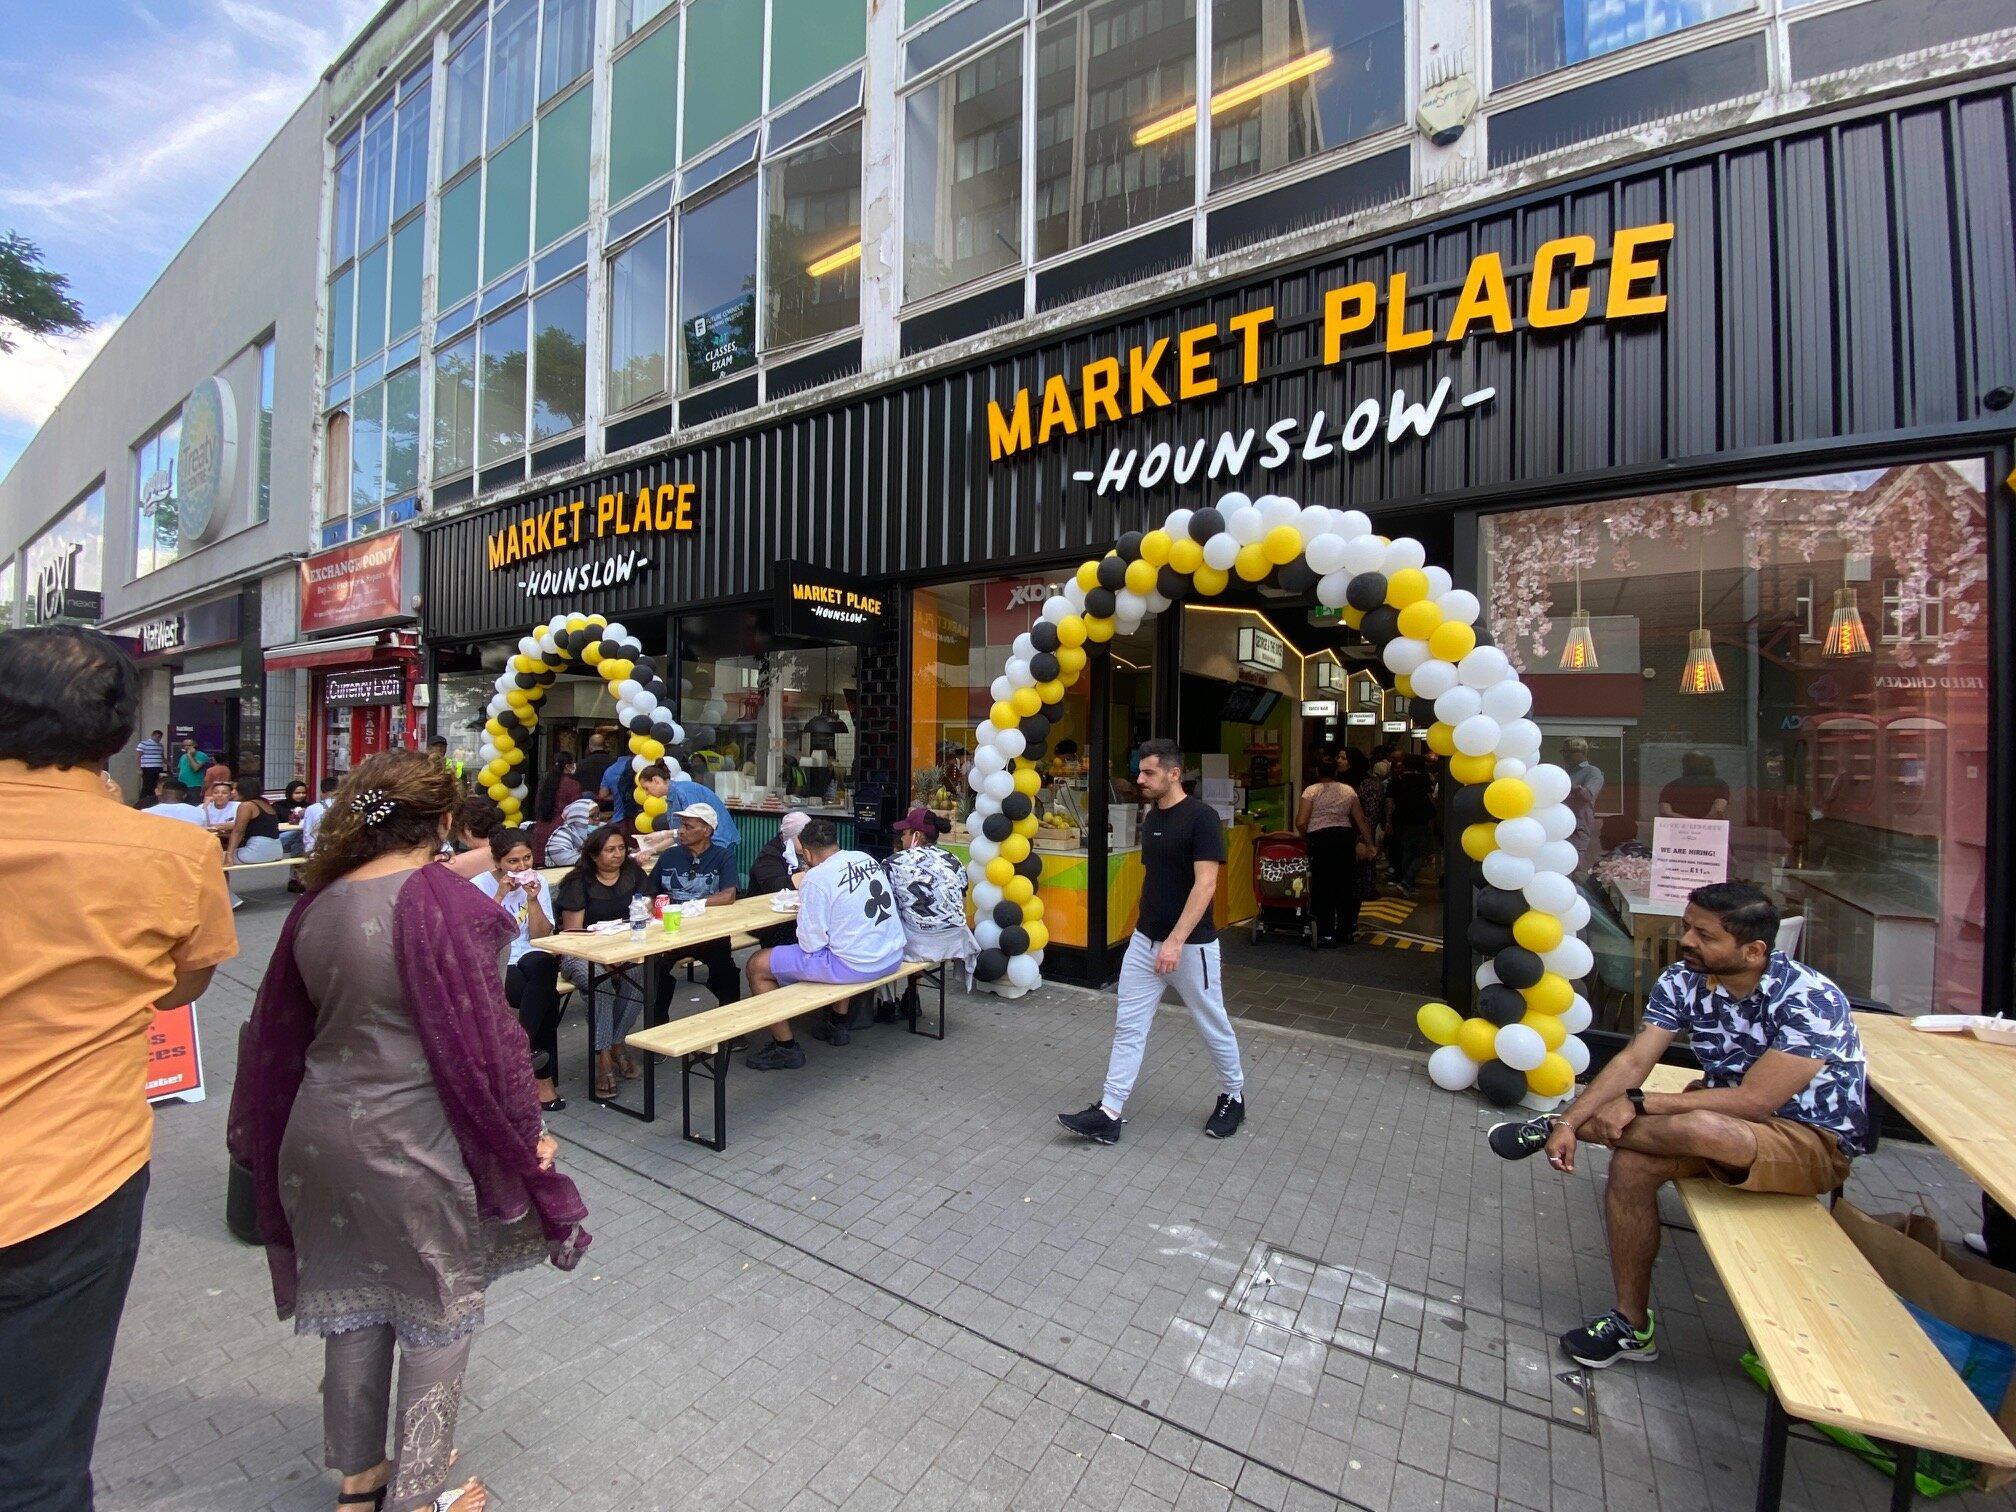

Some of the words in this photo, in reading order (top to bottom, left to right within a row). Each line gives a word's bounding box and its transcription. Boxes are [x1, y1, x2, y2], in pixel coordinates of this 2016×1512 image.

[705, 341, 738, 362] CLASSES,
[987, 305, 1275, 462] MARKET
[1323, 223, 1674, 366] PLACE
[711, 355, 733, 372] EXAM
[183, 435, 216, 478] Treaty
[488, 501, 584, 571] MARKET
[597, 483, 696, 538] PLACE
[361, 546, 395, 569] POINT
[36, 543, 83, 624] next
[793, 583, 842, 605] MARKET
[846, 592, 882, 615] PLACE
[66, 598, 98, 609] next
[143, 616, 179, 653] NatWest
[329, 680, 371, 702] Currency
[365, 711, 375, 745] FAST
[1689, 849, 1716, 857] HIRING!
